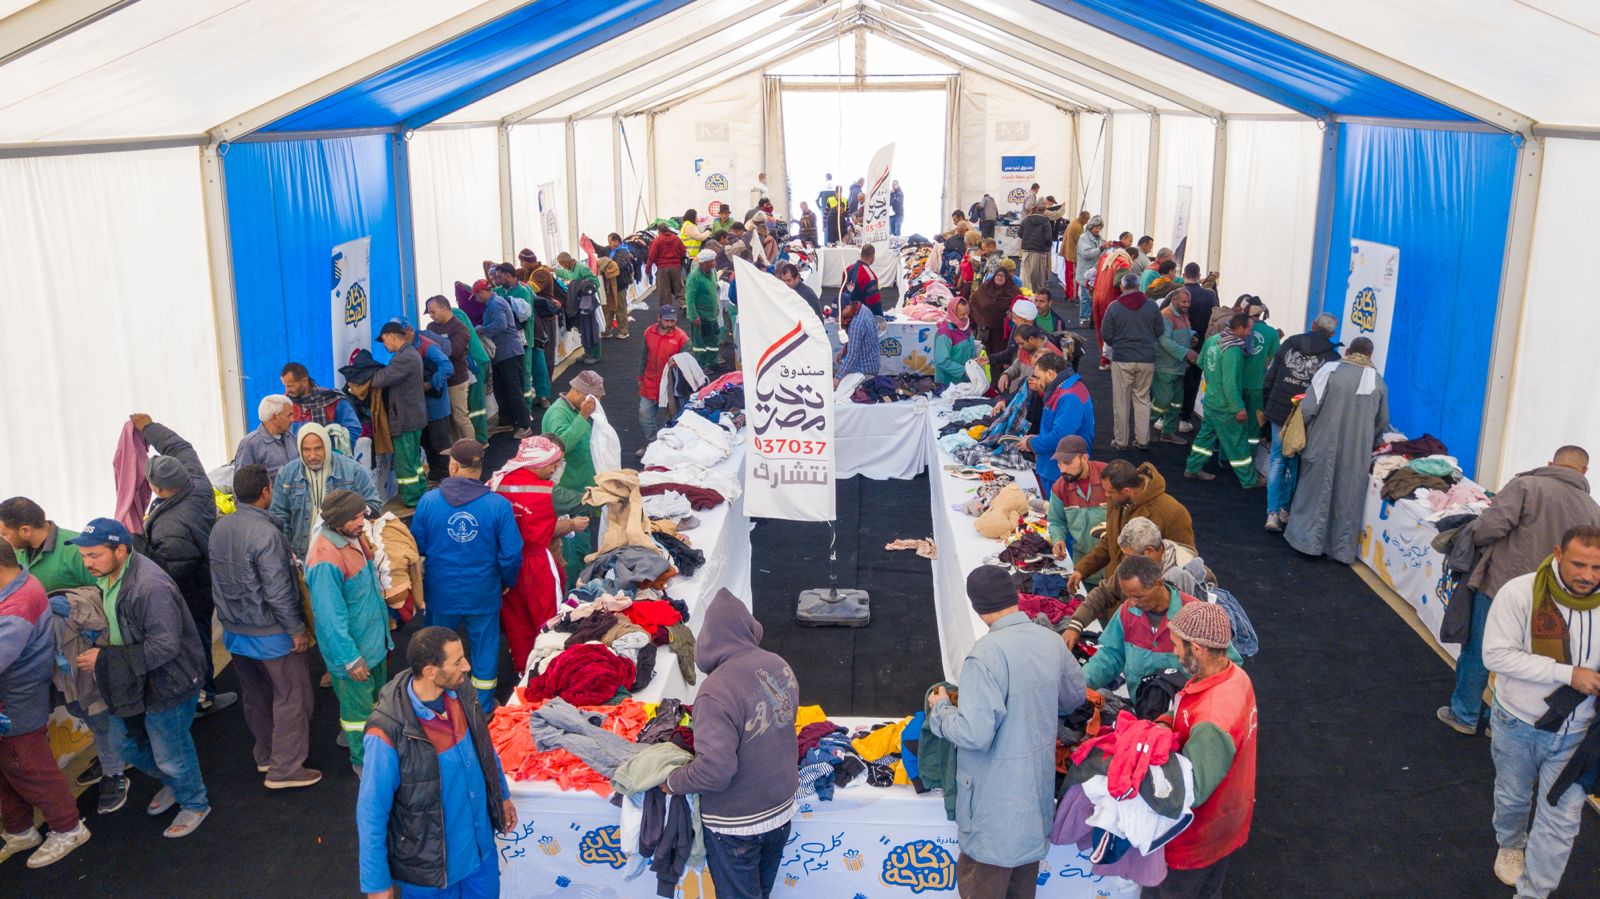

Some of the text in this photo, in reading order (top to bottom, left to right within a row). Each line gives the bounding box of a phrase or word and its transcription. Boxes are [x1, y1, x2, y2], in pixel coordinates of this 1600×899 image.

[780, 365, 825, 379] صندوق
[754, 405, 826, 435] مصر
[755, 437, 827, 455] 037037
[753, 461, 828, 489] نتشارك
